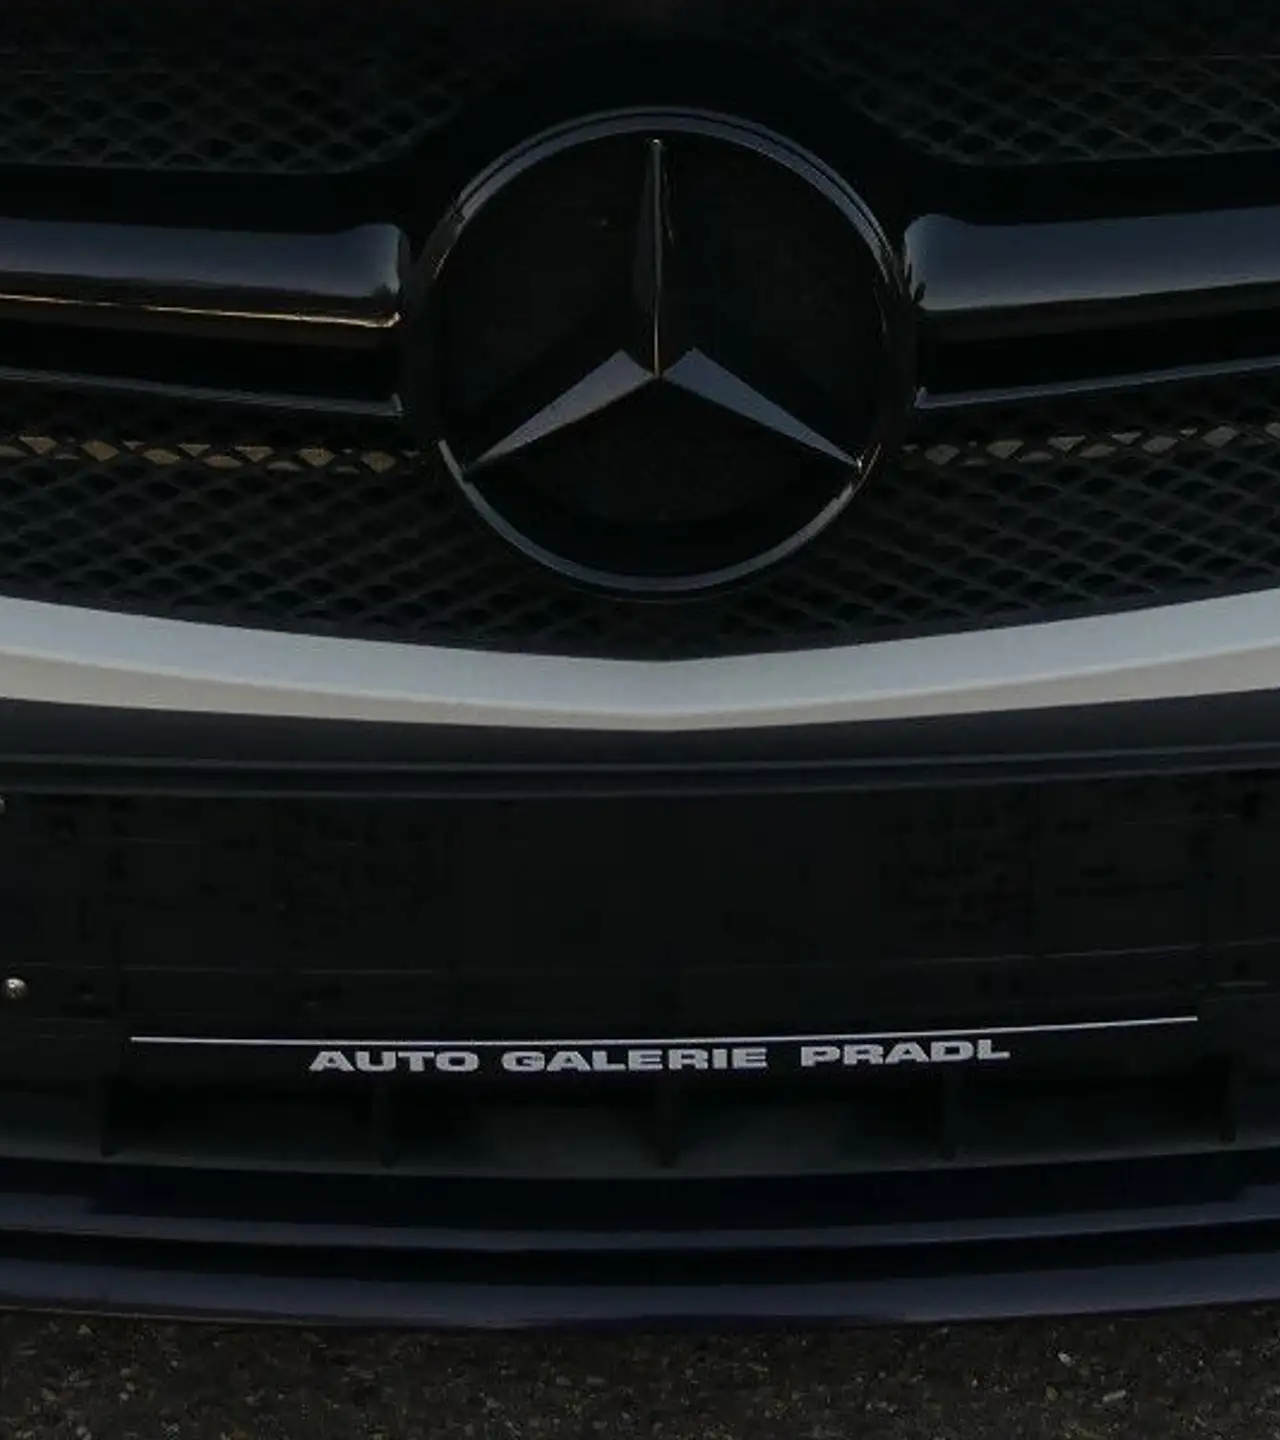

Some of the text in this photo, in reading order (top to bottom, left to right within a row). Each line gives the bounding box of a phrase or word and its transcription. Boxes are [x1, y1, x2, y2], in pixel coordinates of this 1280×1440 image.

[309, 1038, 1011, 1072] AUTO GALERIE PRADL
